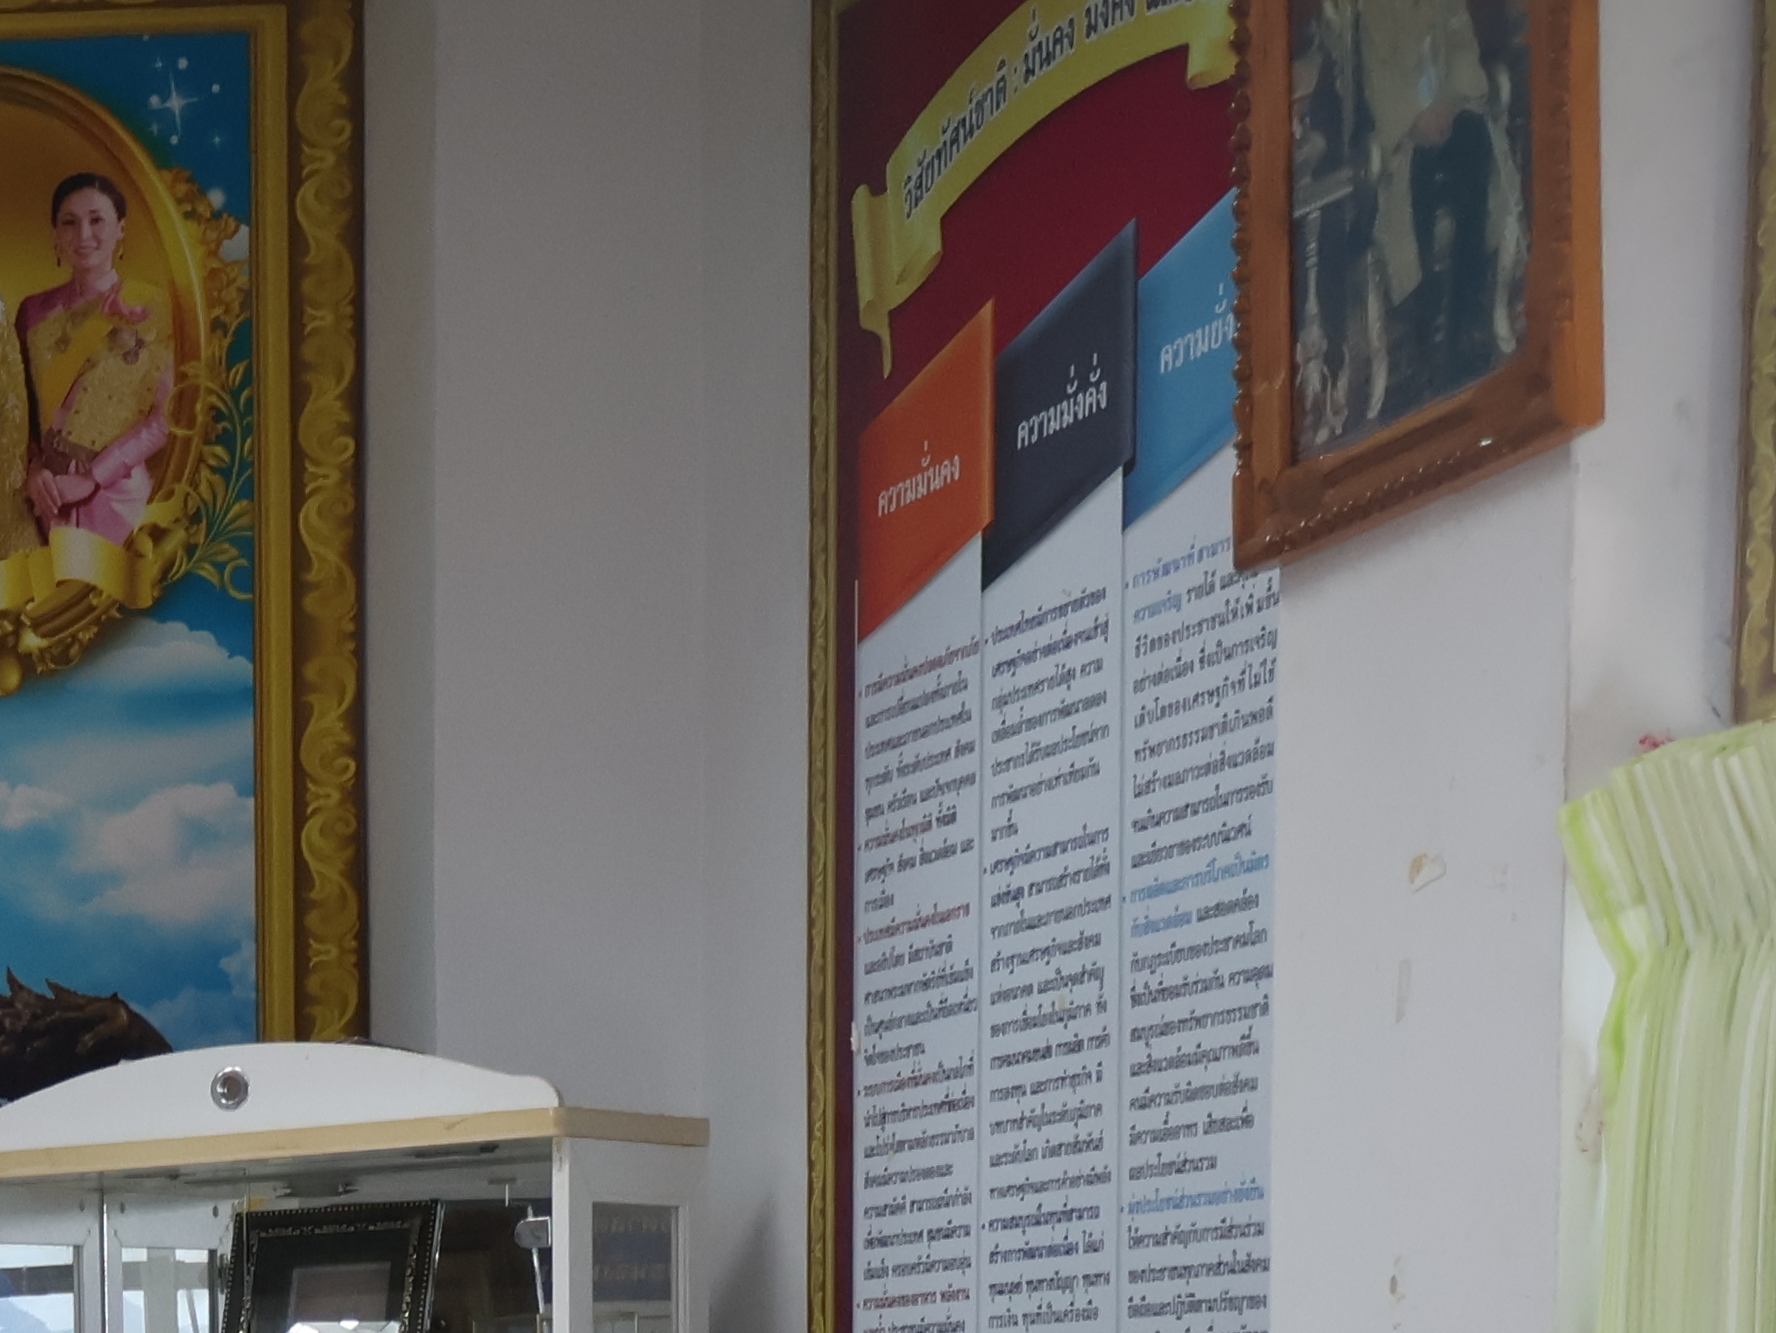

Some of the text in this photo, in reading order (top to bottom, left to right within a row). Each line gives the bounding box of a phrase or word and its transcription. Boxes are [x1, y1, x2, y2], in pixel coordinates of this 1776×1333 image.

[1024, 8, 1075, 85] มั่นคง
[1016, 353, 1108, 450] ความมั่งคั่ง
[877, 440, 961, 517] ความมั่นคง
